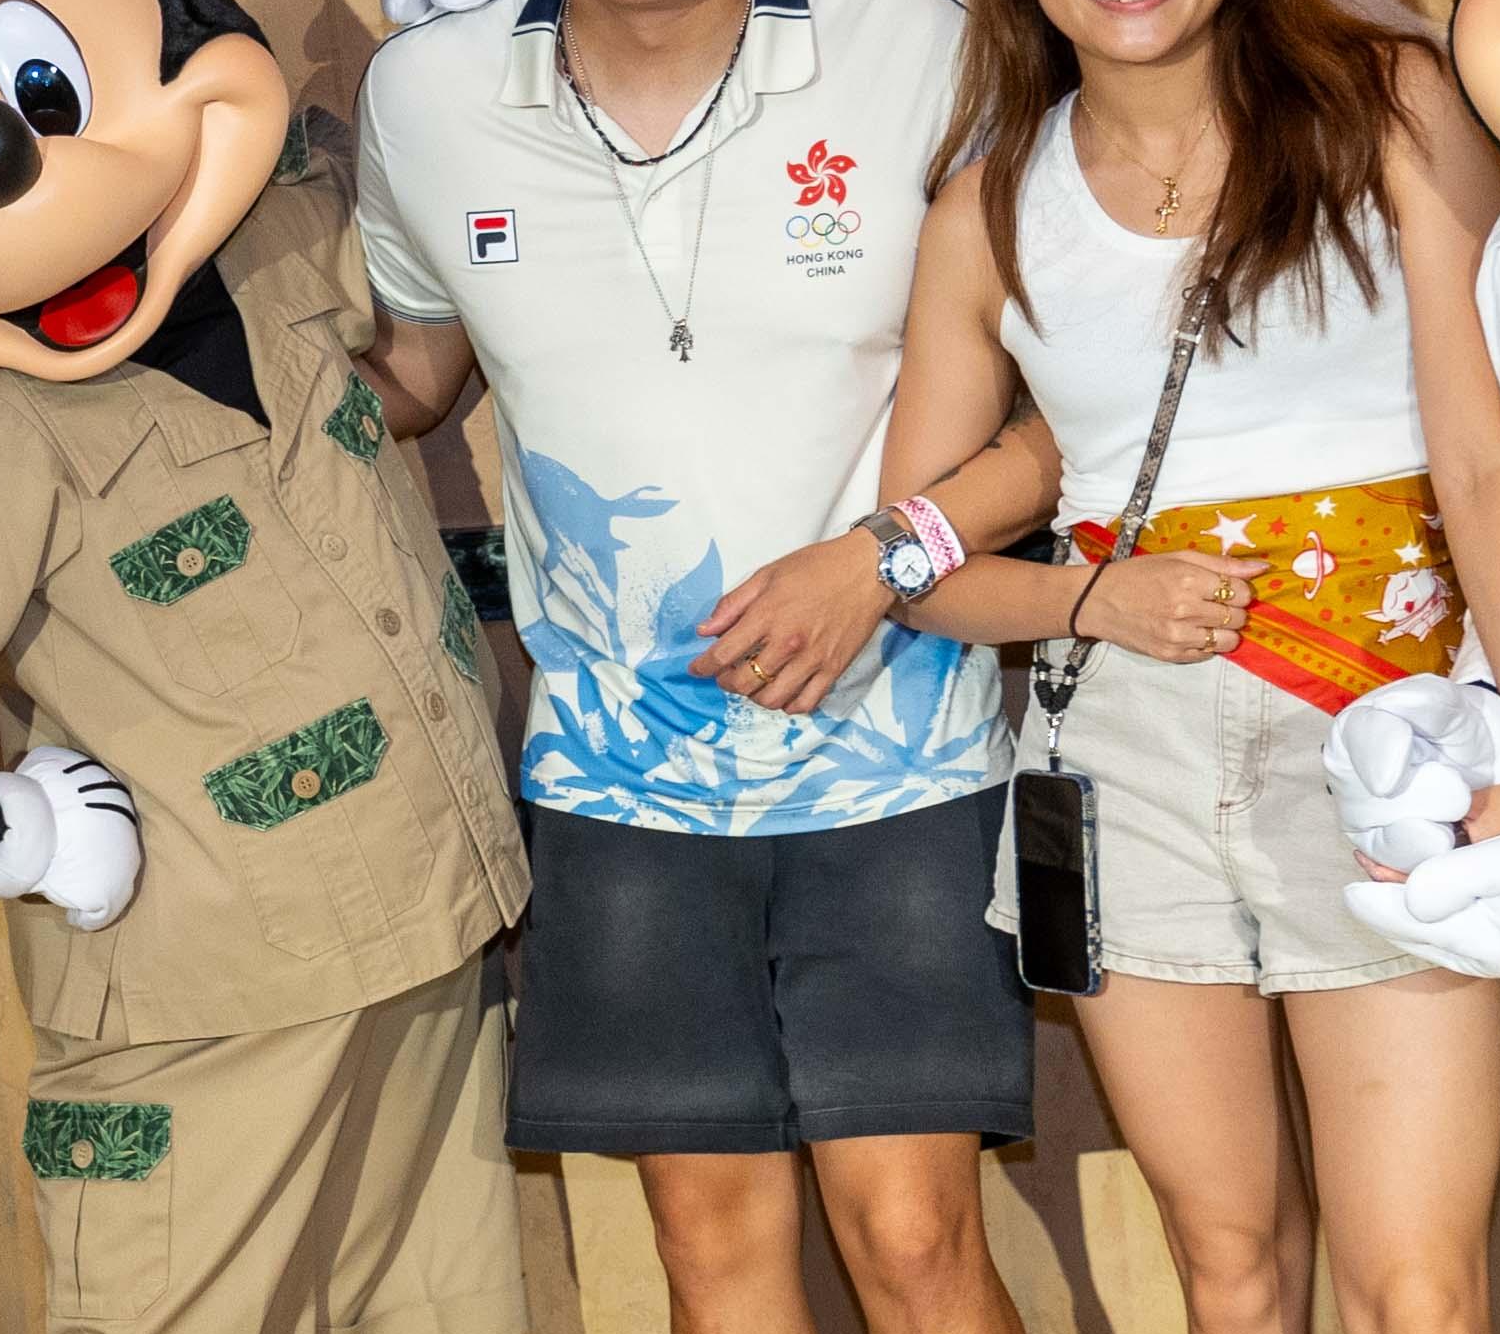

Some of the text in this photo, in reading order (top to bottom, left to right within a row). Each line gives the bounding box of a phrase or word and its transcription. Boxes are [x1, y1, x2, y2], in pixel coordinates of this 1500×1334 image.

[786, 249, 864, 265] HONG KONG
[806, 265, 846, 278] CHINA
